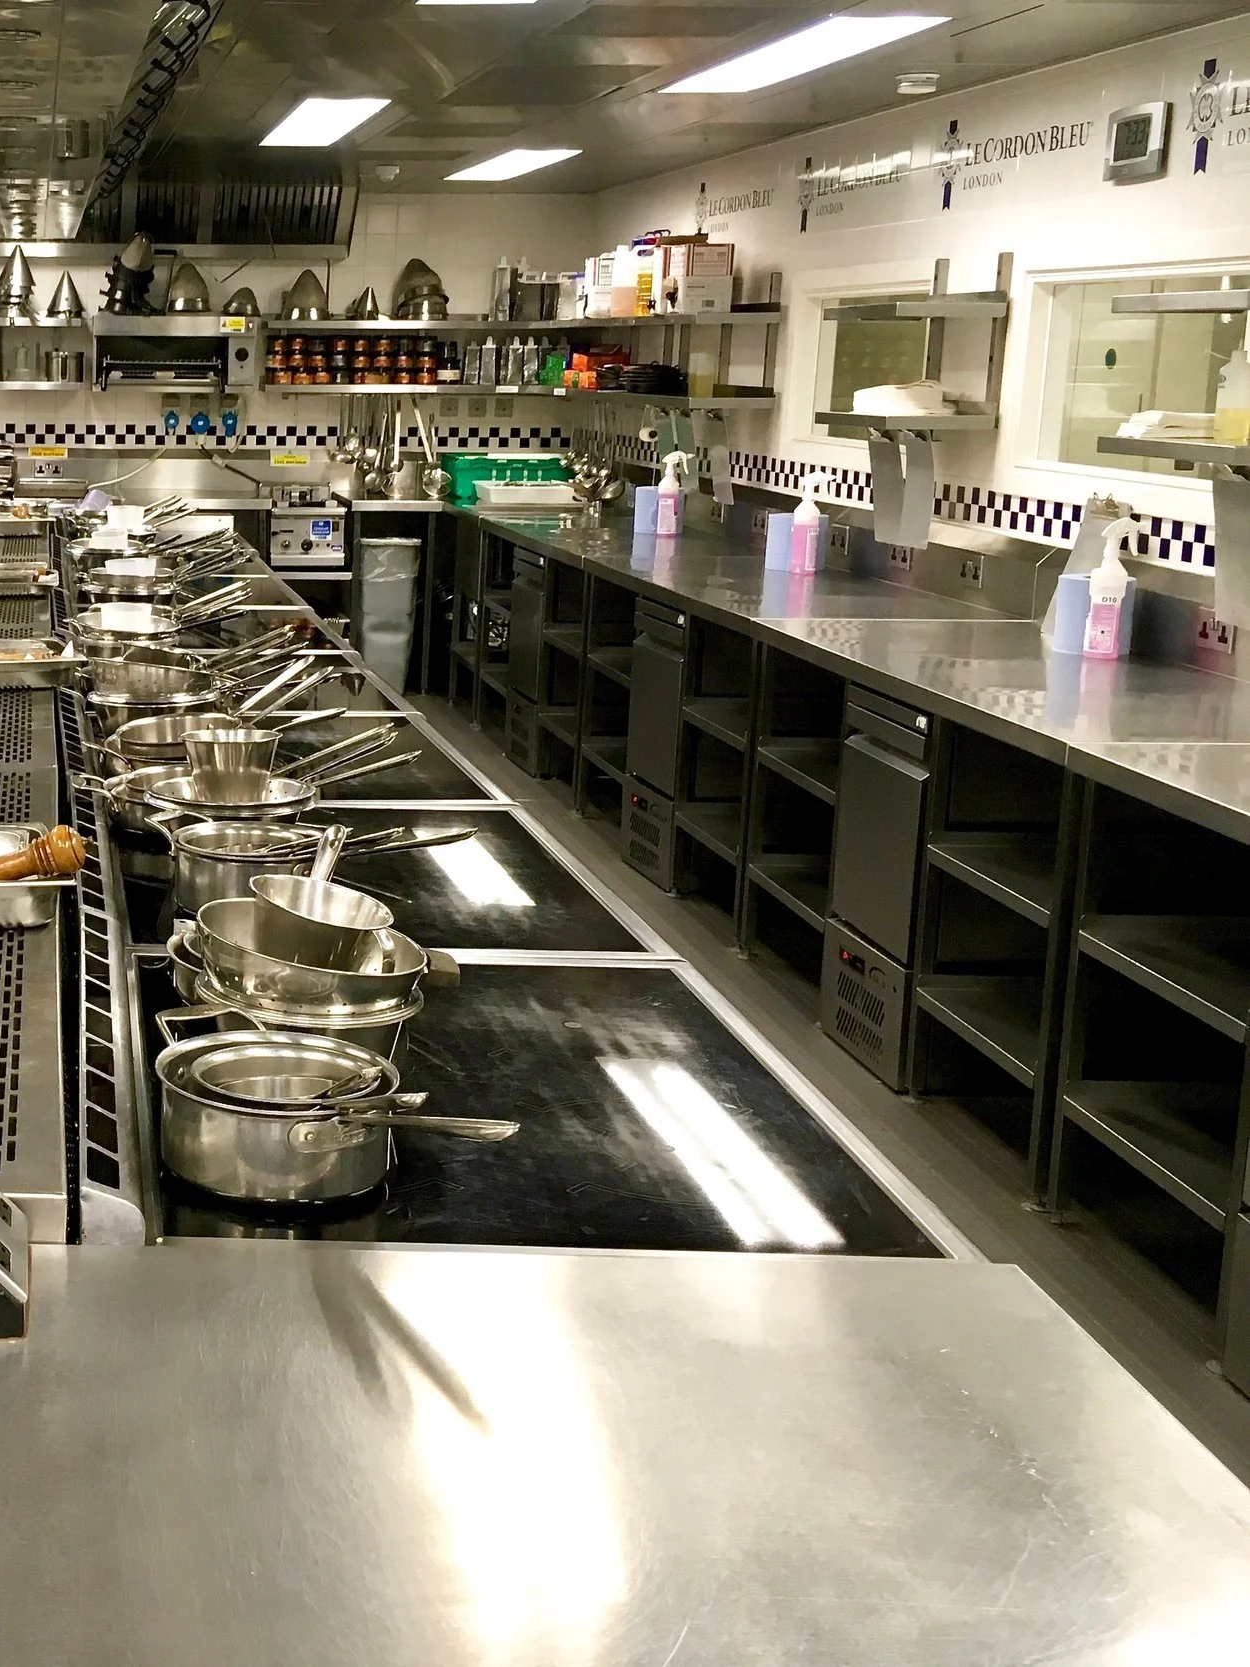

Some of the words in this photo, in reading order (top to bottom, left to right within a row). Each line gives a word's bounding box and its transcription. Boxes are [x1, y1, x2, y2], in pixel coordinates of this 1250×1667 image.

[983, 130, 1048, 163] CORDON
[1048, 121, 1092, 152] BLEU
[963, 171, 1004, 190] LONDON
[815, 202, 844, 217] LONDON
